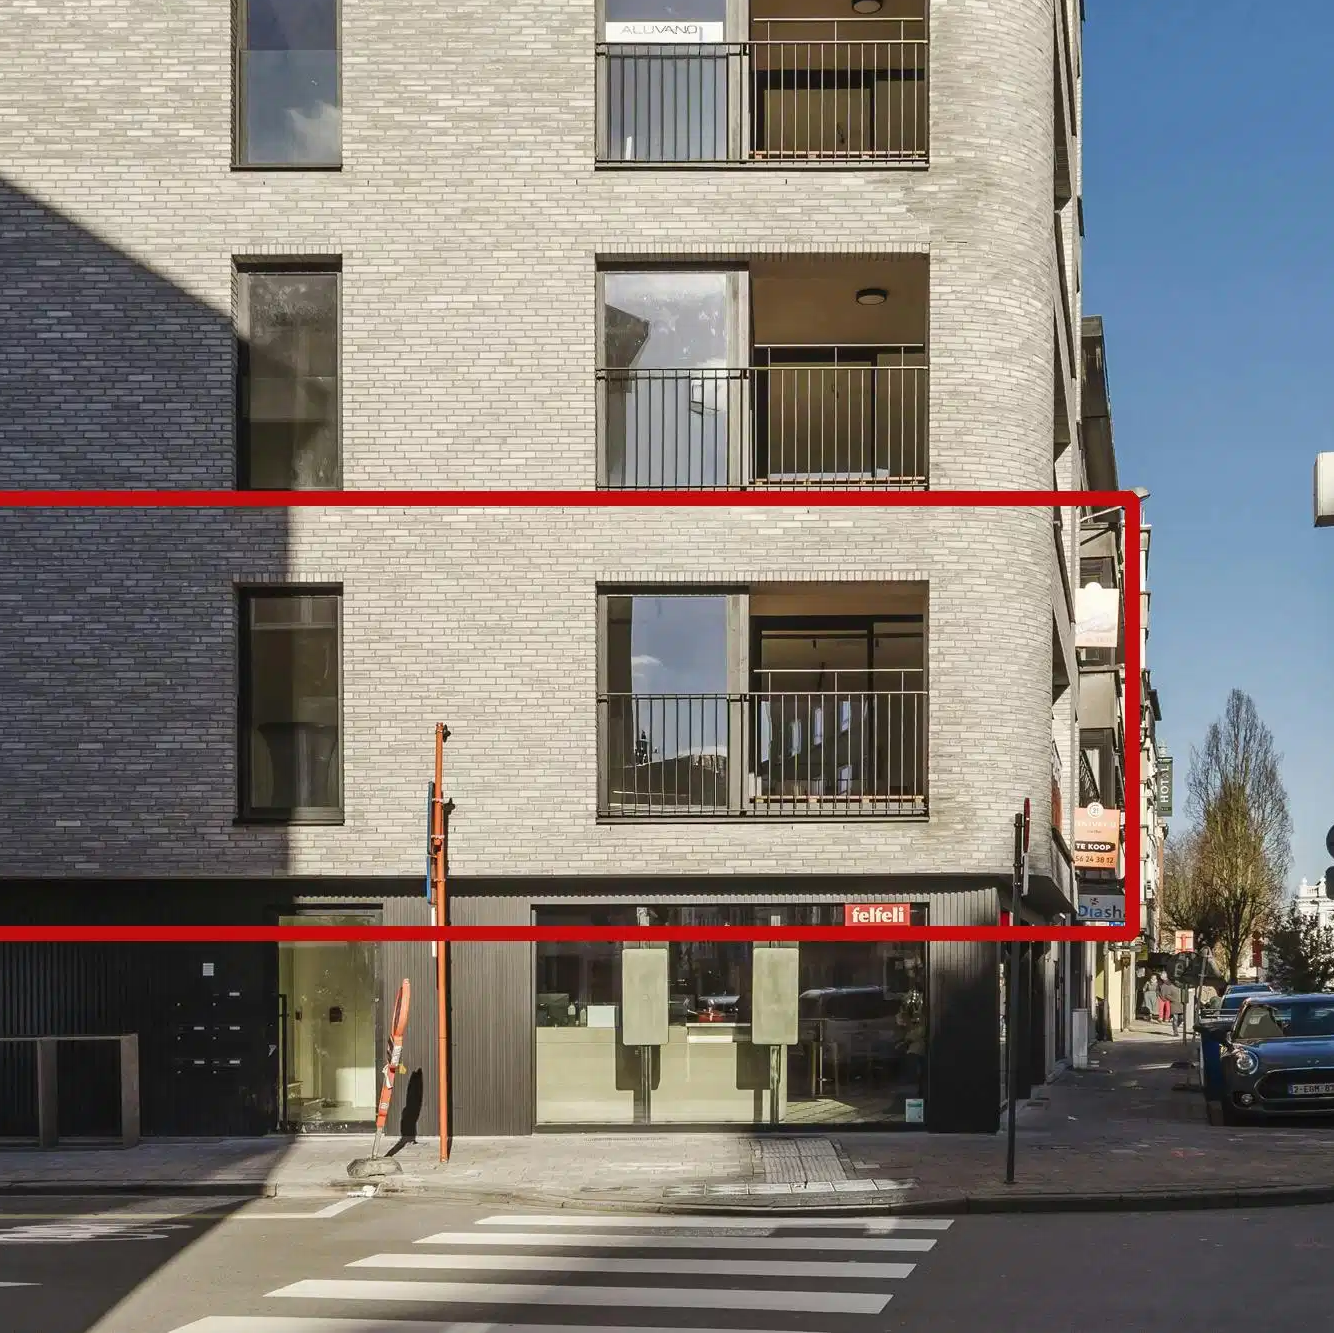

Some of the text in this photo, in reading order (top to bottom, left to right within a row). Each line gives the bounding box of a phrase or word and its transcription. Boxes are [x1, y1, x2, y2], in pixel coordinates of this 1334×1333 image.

[1088, 843, 1111, 851] KOOP
[1085, 855, 1094, 863] 24
[852, 906, 904, 923] felfeli
